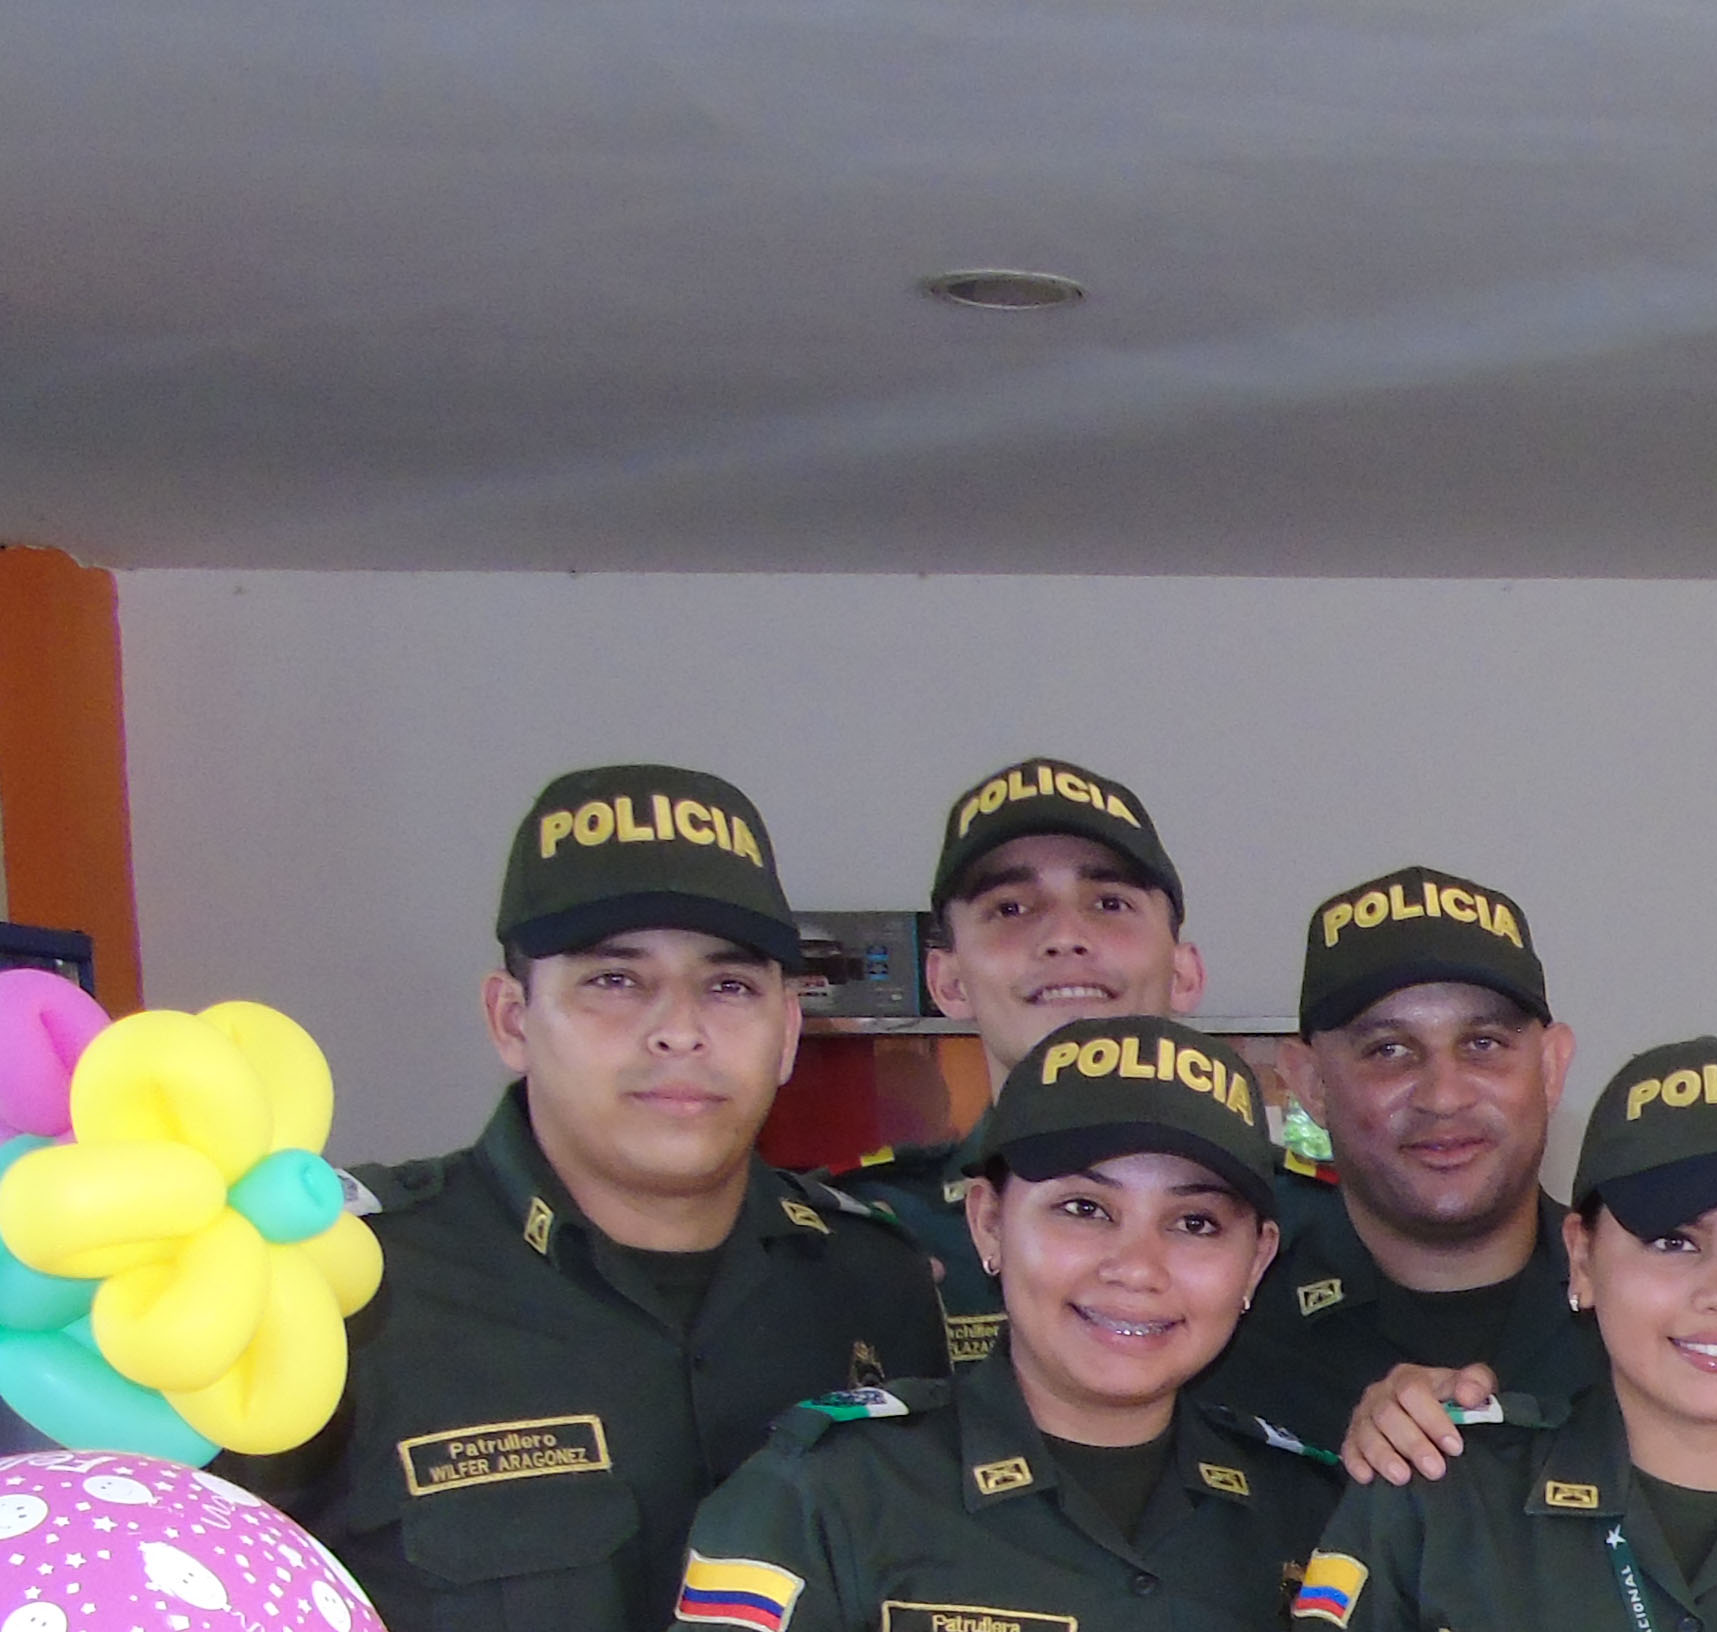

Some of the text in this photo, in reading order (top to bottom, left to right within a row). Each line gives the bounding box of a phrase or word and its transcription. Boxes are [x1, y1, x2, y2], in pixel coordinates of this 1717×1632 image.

[540, 794, 764, 867] POLICIA
[959, 767, 1140, 838] POLICIA
[1323, 882, 1524, 949] POLICIA
[1042, 1037, 1255, 1125] POLICIA
[428, 1447, 590, 1483] WILFER ARAGONEZ
[448, 1432, 558, 1460] Patrullero
